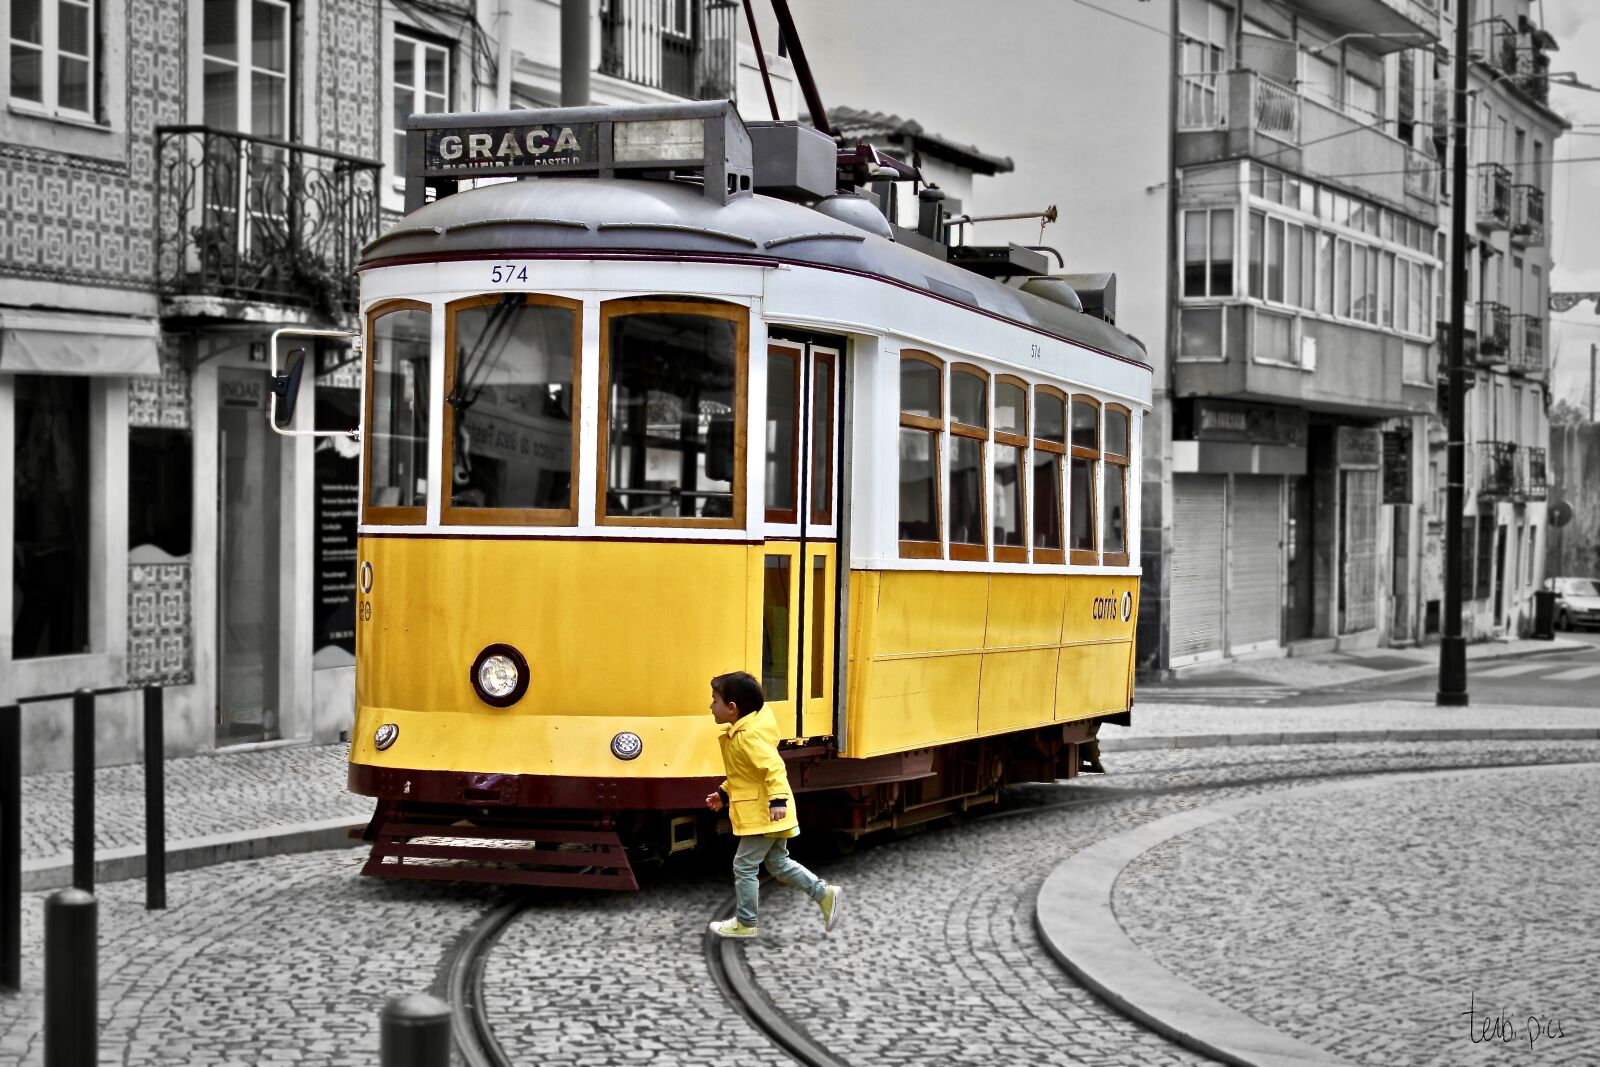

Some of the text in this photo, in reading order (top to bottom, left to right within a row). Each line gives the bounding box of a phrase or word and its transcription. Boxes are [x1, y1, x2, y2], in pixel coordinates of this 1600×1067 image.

[440, 128, 581, 160] GRAÇA
[491, 264, 529, 283] 574
[1031, 344, 1041, 359] 574
[1092, 589, 1117, 620] carris
